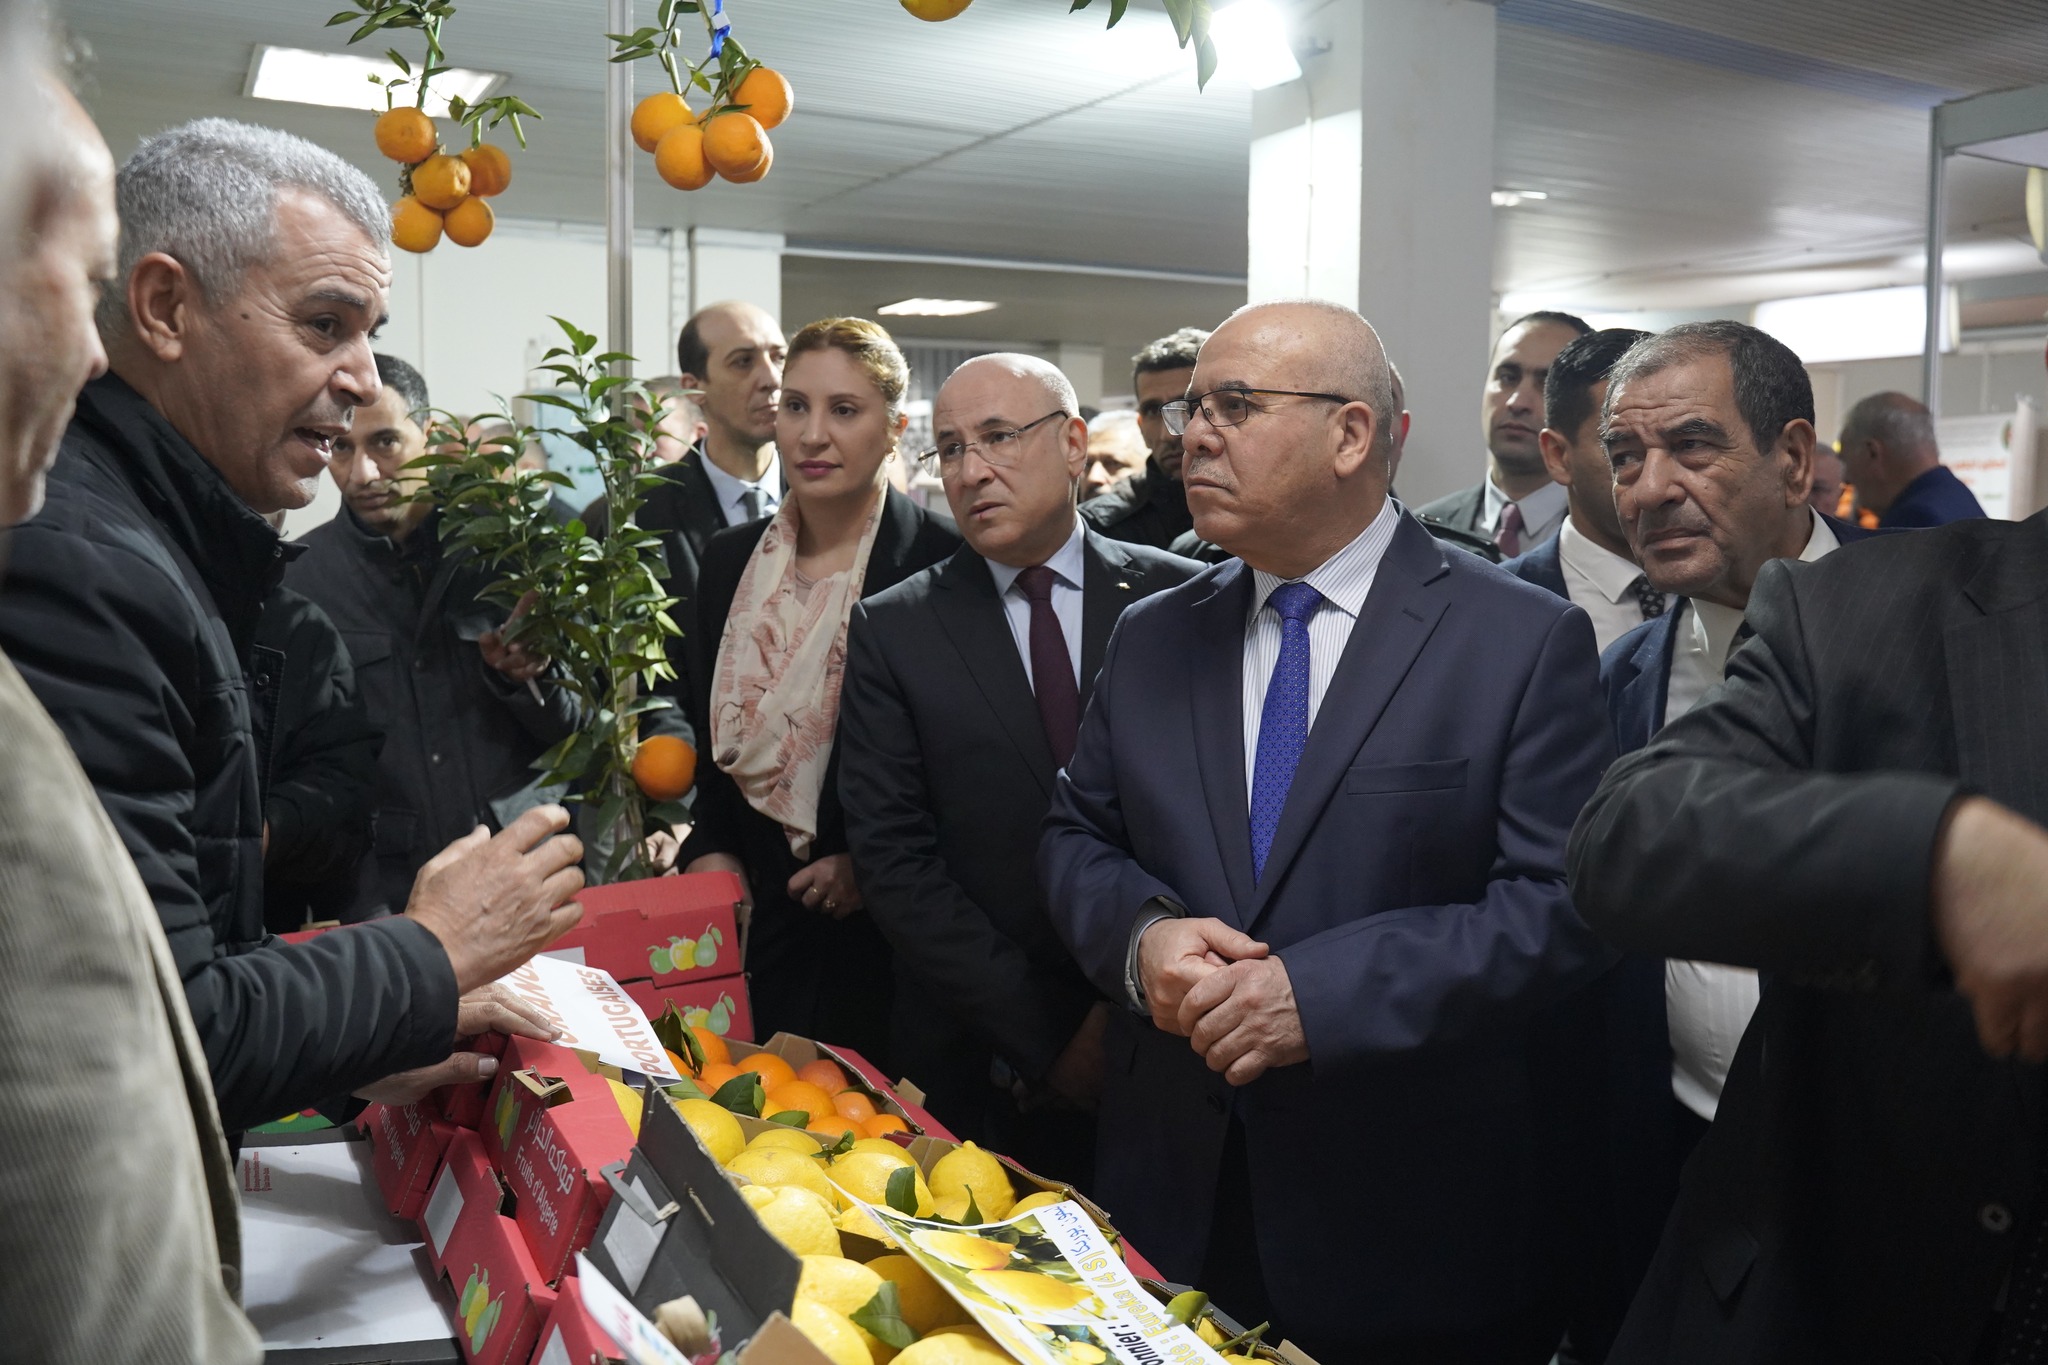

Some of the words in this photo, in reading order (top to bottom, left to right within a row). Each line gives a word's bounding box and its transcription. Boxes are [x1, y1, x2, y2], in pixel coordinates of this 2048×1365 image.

[576, 968, 671, 1075] PORTUGAISES
[525, 1107, 554, 1154] الجزائر
[515, 1144, 535, 1189] Fruits
[532, 1178, 559, 1237] d'Algérie
[547, 1143, 577, 1195] فواكه
[1113, 1289, 1171, 1339] Eureka
